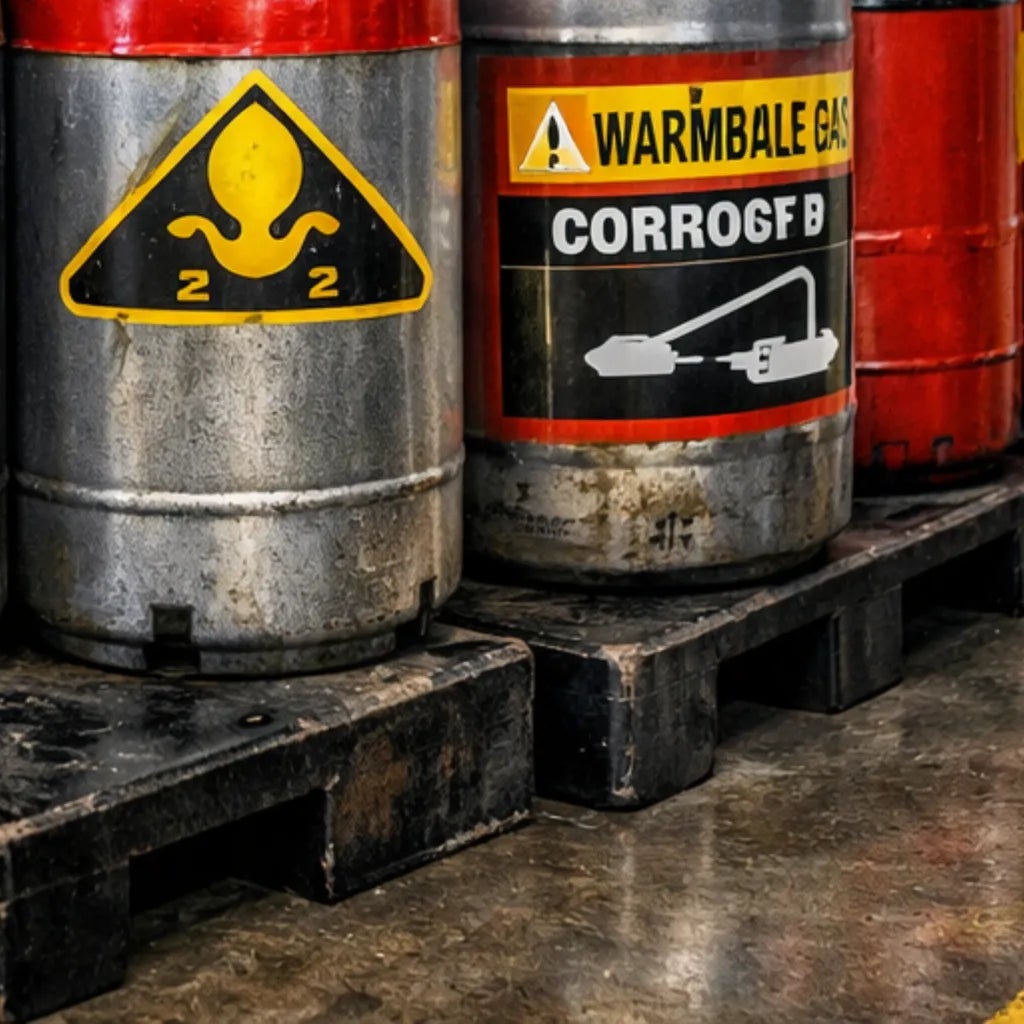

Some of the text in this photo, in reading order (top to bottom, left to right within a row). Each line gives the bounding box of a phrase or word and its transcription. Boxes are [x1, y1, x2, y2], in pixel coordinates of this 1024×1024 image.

[592, 95, 850, 168] WARMBALE GAS
[176, 265, 339, 302] 2 2
